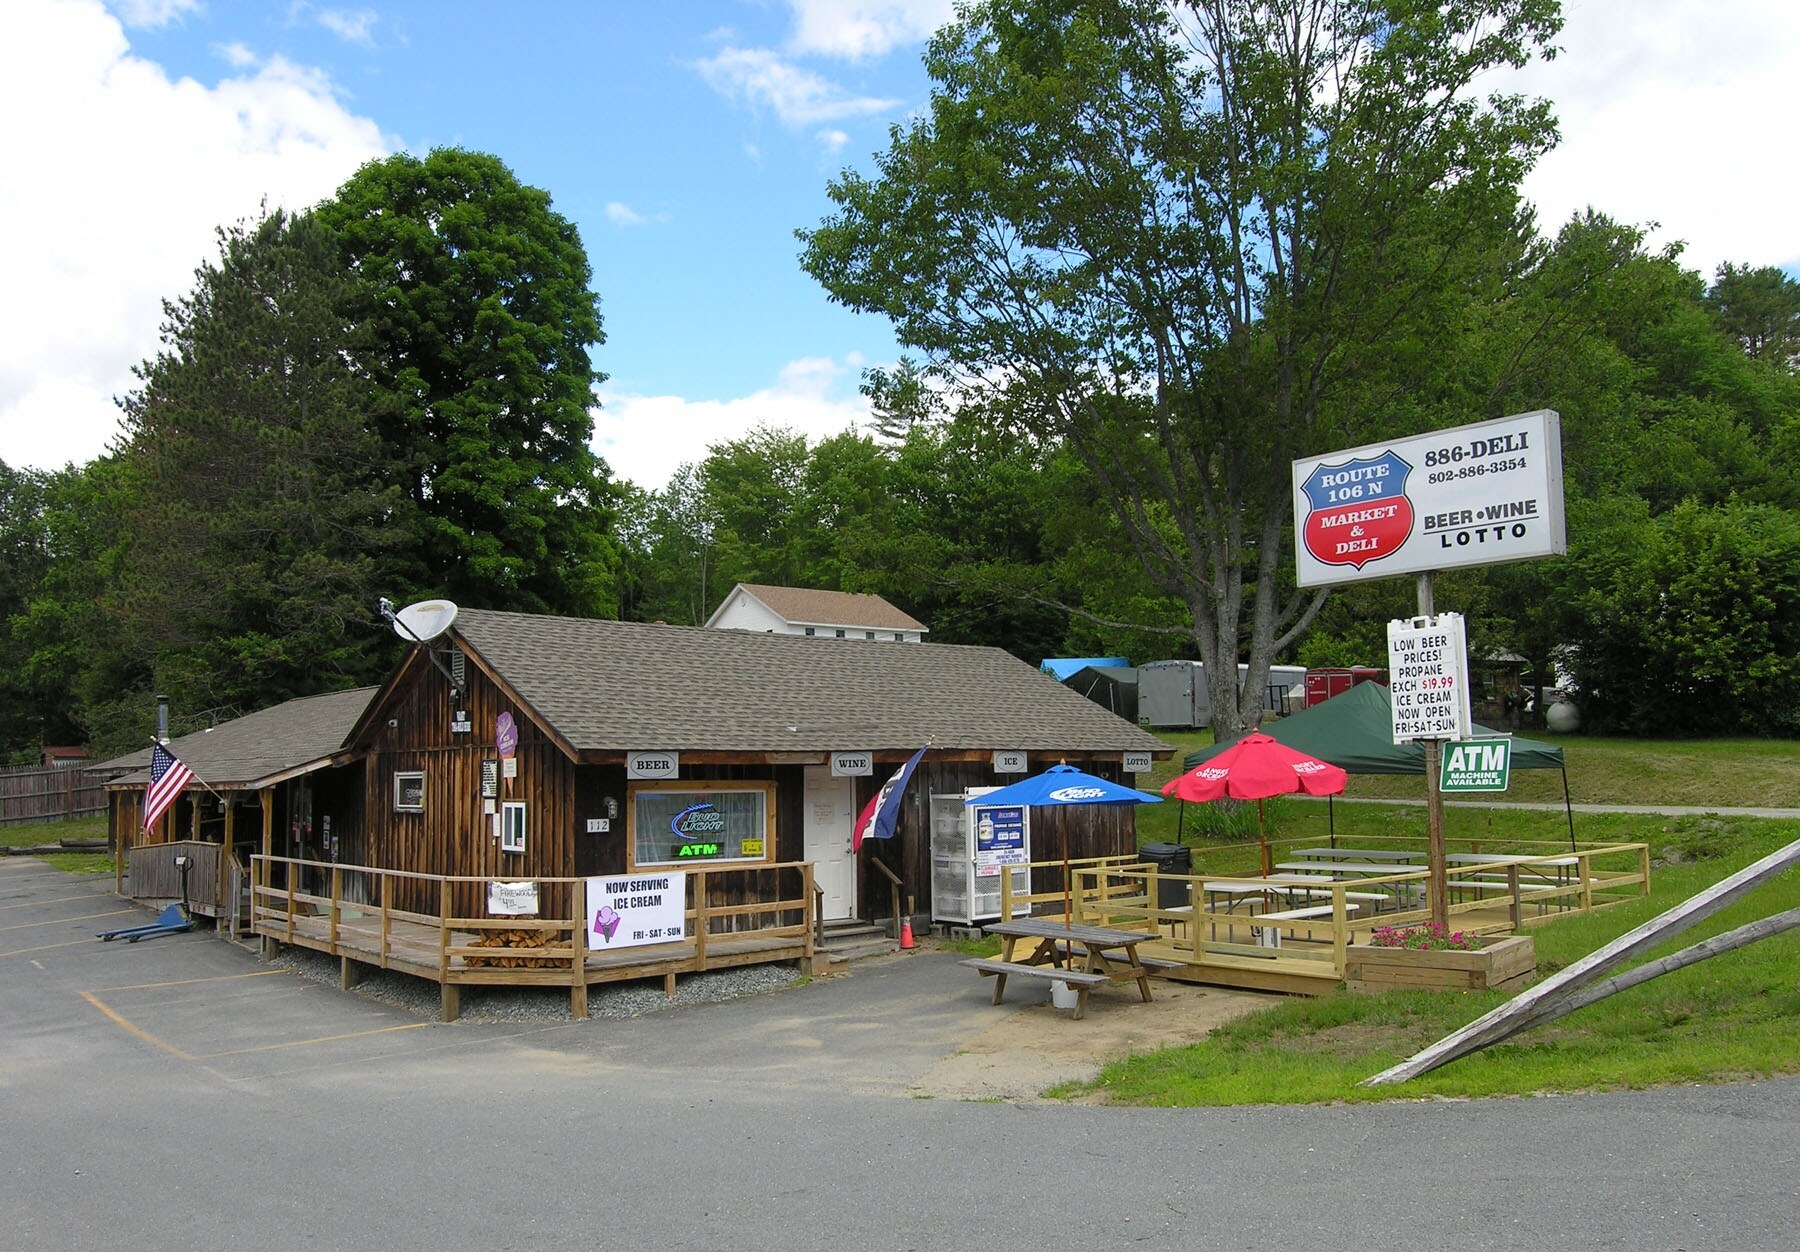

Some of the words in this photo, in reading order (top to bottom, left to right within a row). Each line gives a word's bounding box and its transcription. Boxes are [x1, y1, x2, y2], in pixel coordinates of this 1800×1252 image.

[1425, 432, 1529, 467] 886-DELI
[1321, 463, 1389, 488] ROUTE
[1428, 457, 1527, 485] 802-886-3354
[1328, 487, 1363, 502] 106
[1368, 481, 1383, 496] N
[1320, 504, 1398, 529] MARKET
[1424, 509, 1473, 530] BEER
[1485, 499, 1537, 521] WINE
[1350, 525, 1364, 537] &
[1441, 523, 1526, 548] LOTTO
[1335, 537, 1378, 555] DELI
[1394, 639, 1415, 652] LOW
[1422, 635, 1447, 648] BEER
[1404, 651, 1442, 664] PRICES!
[1399, 664, 1443, 678] PROPANE
[1392, 680, 1417, 693] EXCH
[1422, 676, 1453, 690] $19.99
[1397, 695, 1412, 706] ICE
[1417, 691, 1452, 705] CREAM
[1398, 708, 1420, 720] NOW
[1425, 706, 1451, 718] OPEN
[636, 760, 670, 770] BEER
[839, 759, 867, 768] WINE
[1004, 757, 1018, 766] ICE
[1126, 757, 1149, 766] LOTTO
[1447, 745, 1505, 772] ATM
[1446, 778, 1502, 786] AVAILABLE
[688, 812, 720, 822] BUD
[590, 821, 608, 831] 112
[681, 821, 724, 831] LIGHT
[679, 844, 717, 856] ATM
[606, 882, 628, 895] NOW
[630, 879, 669, 892] SERVING
[613, 898, 629, 910] ICE
[630, 895, 662, 908] CREAM
[633, 930, 644, 940] FRI
[649, 929, 662, 939] SAT
[667, 927, 681, 937] SUN
